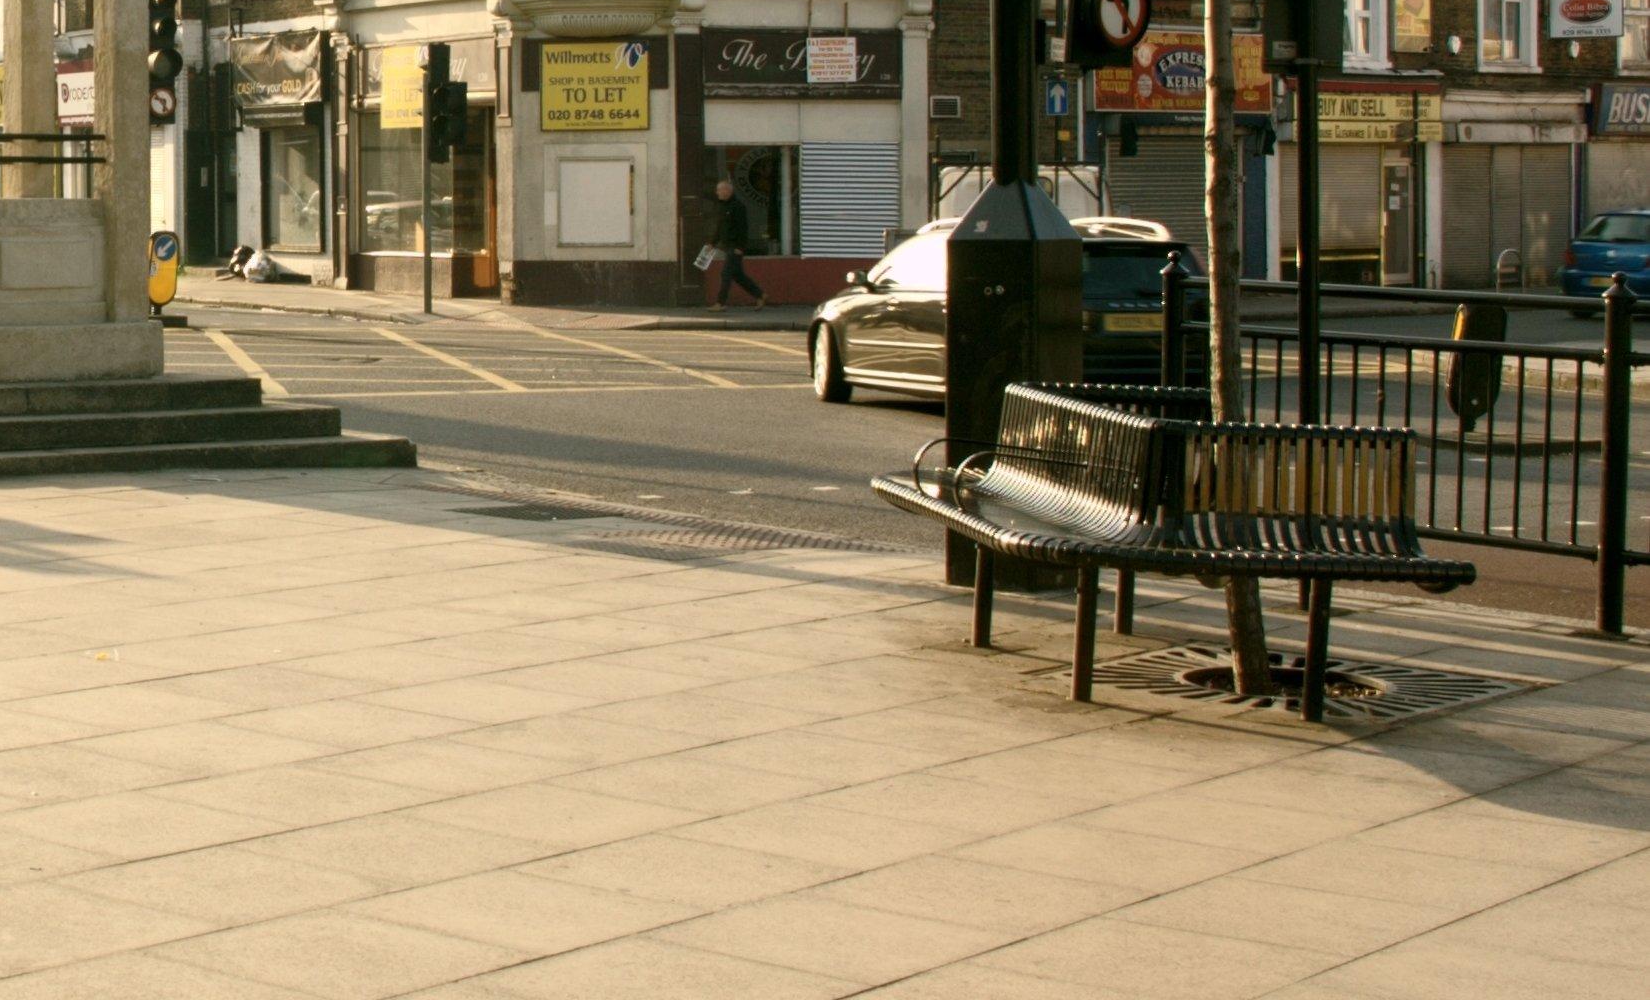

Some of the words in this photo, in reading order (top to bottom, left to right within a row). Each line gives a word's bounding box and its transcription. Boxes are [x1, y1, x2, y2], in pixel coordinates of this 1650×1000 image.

[545, 50, 612, 65] Willmotts
[717, 38, 769, 72] The
[237, 81, 257, 95] CASH
[267, 83, 282, 96] your
[281, 78, 302, 94] GOLD
[548, 76, 573, 86] SHOP
[588, 75, 641, 86] BASEMENT
[1165, 74, 1206, 88] KEBAB
[562, 87, 587, 104] TO
[593, 86, 627, 104] LET
[548, 109, 571, 121] 020
[574, 108, 605, 121] 8748
[608, 108, 641, 120] 6644
[1318, 98, 1338, 117] BUY
[1339, 98, 1359, 117] AND
[1360, 98, 1387, 118] SELL
